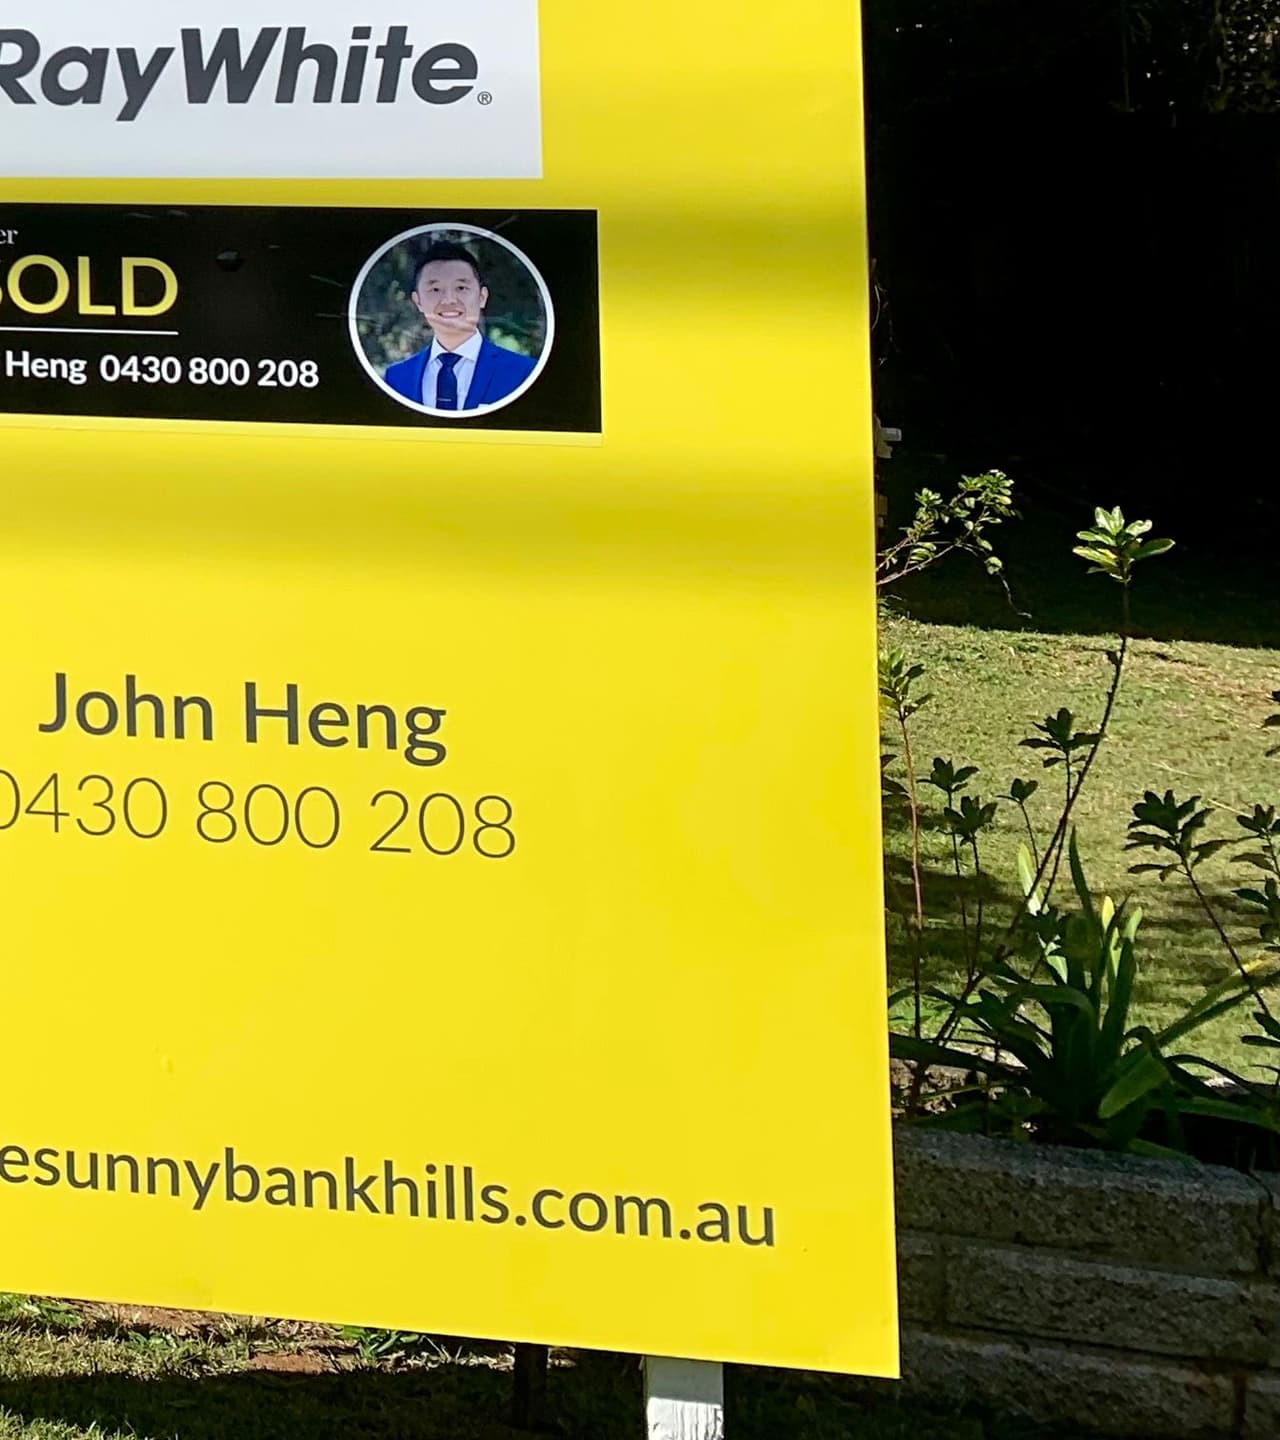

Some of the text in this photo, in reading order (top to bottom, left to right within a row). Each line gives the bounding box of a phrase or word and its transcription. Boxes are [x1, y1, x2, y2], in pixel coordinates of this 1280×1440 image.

[5, 350, 88, 385] Heng
[99, 354, 182, 384] 0430
[188, 357, 251, 386] 800
[257, 359, 320, 388] 208
[38, 672, 448, 767] John Heng
[196, 780, 341, 849] 800
[369, 789, 517, 859] 208
